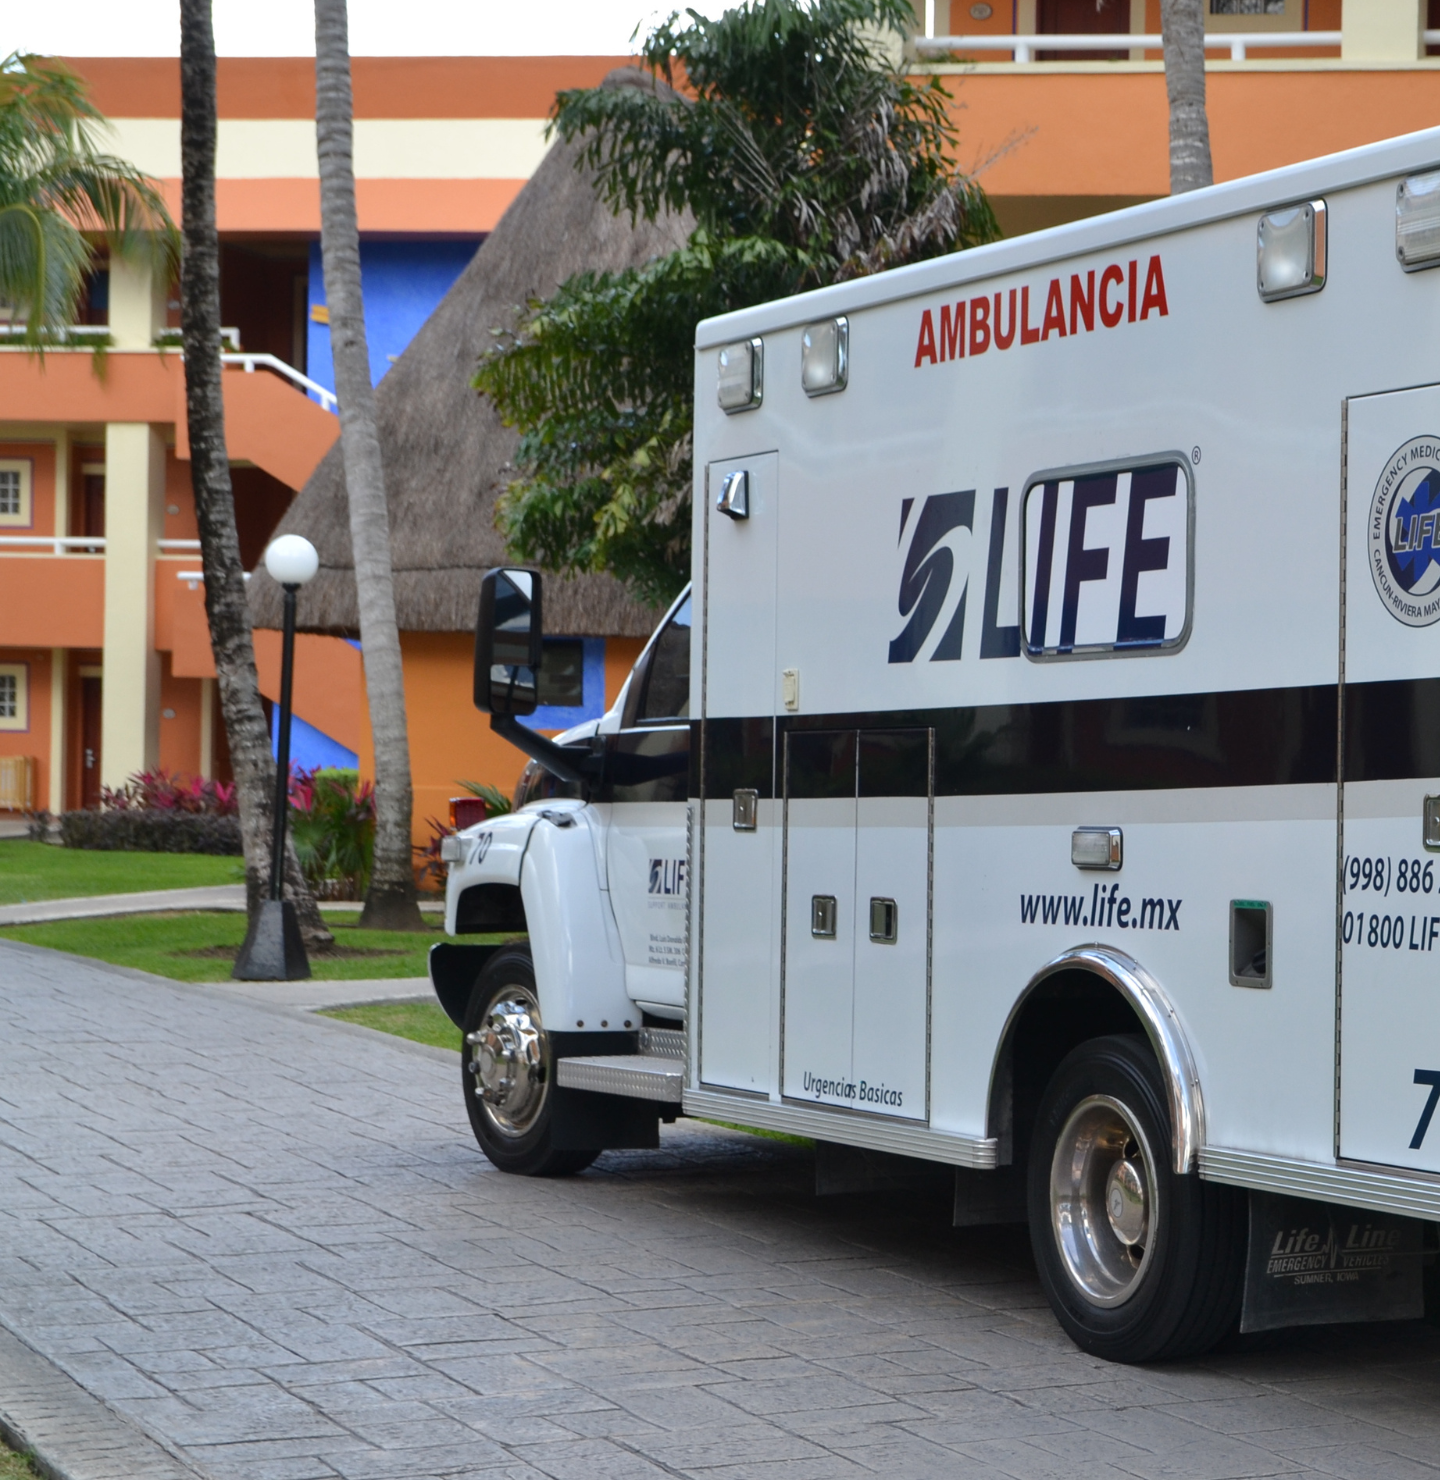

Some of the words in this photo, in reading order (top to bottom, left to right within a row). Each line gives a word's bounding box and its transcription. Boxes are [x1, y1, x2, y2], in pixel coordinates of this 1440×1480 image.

[914, 254, 1169, 368] AMBULANCIA
[1373, 453, 1408, 540] EMERGENCY
[979, 464, 1179, 660] LIFE
[468, 831, 493, 865] 70
[664, 859, 686, 895] LIF
[1342, 855, 1391, 897] (998)
[1396, 858, 1434, 894] 886
[1020, 883, 1183, 931] www.life.mx
[803, 1071, 857, 1099] Urgencias
[859, 1080, 903, 1107] Basicas
[1271, 1228, 1320, 1255] Life
[1345, 1224, 1400, 1249] Line
[1266, 1255, 1329, 1274] EMERGENCY
[1342, 1253, 1391, 1268] VEHICLES
[1294, 1273, 1333, 1285] SUMNER,
[1336, 1272, 1359, 1282] IOWA
